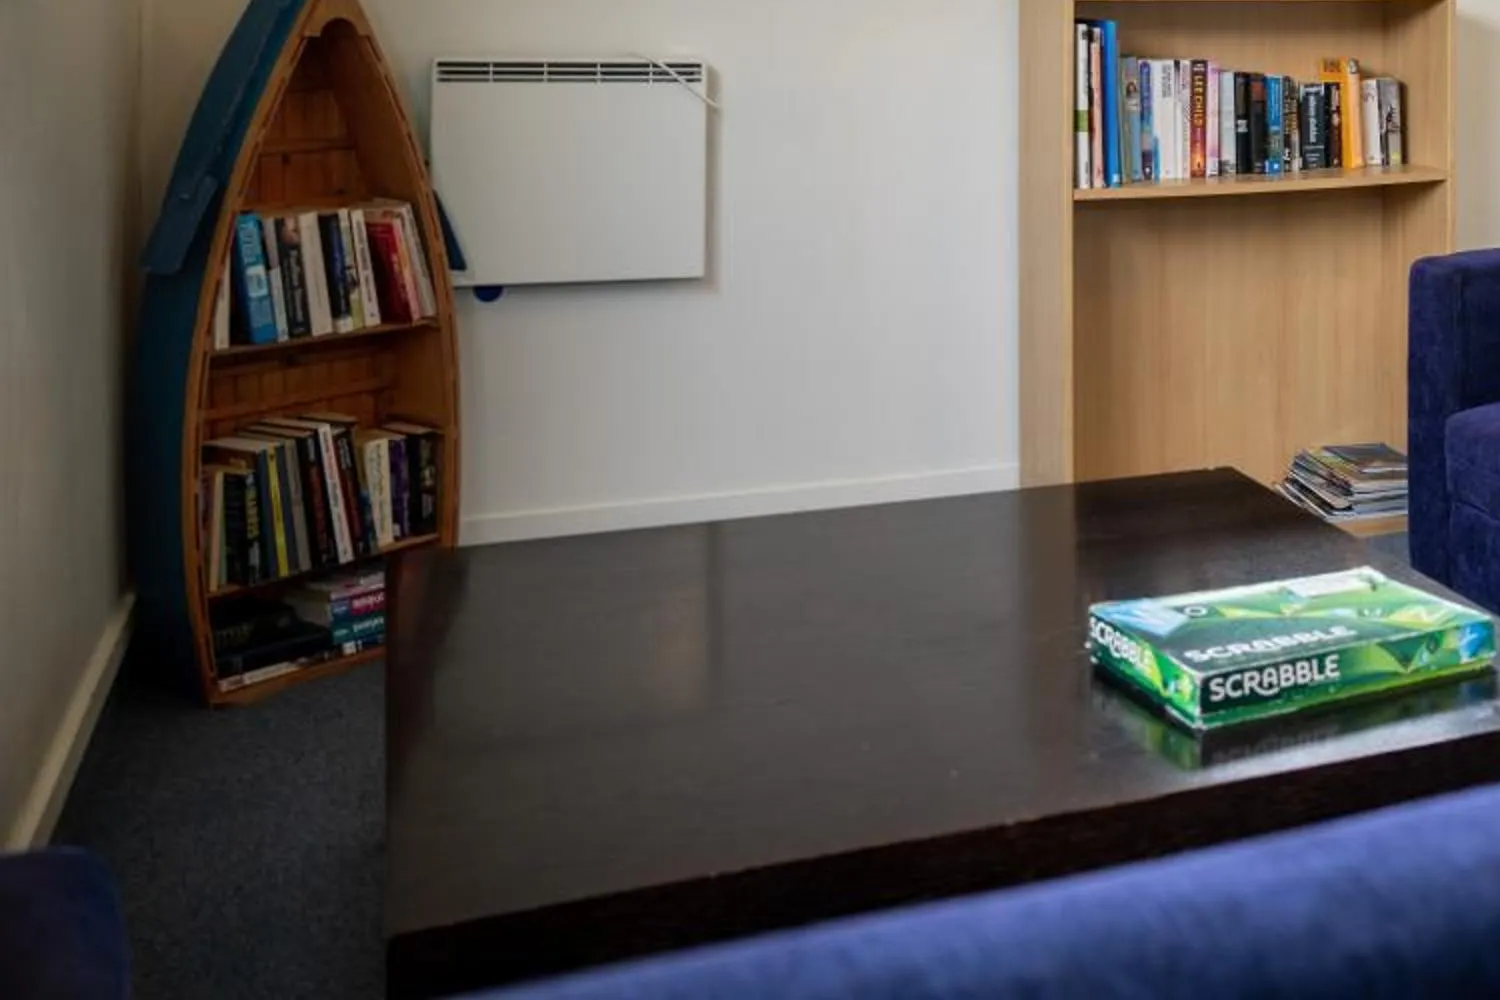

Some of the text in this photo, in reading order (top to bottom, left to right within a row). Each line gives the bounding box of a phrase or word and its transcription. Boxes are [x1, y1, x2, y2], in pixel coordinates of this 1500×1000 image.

[1193, 74, 1206, 127] LEE CHILD
[1090, 617, 1153, 672] SCRABBLE
[1184, 626, 1357, 663] SCRABBLE
[1209, 654, 1340, 702] SCRABBLE
